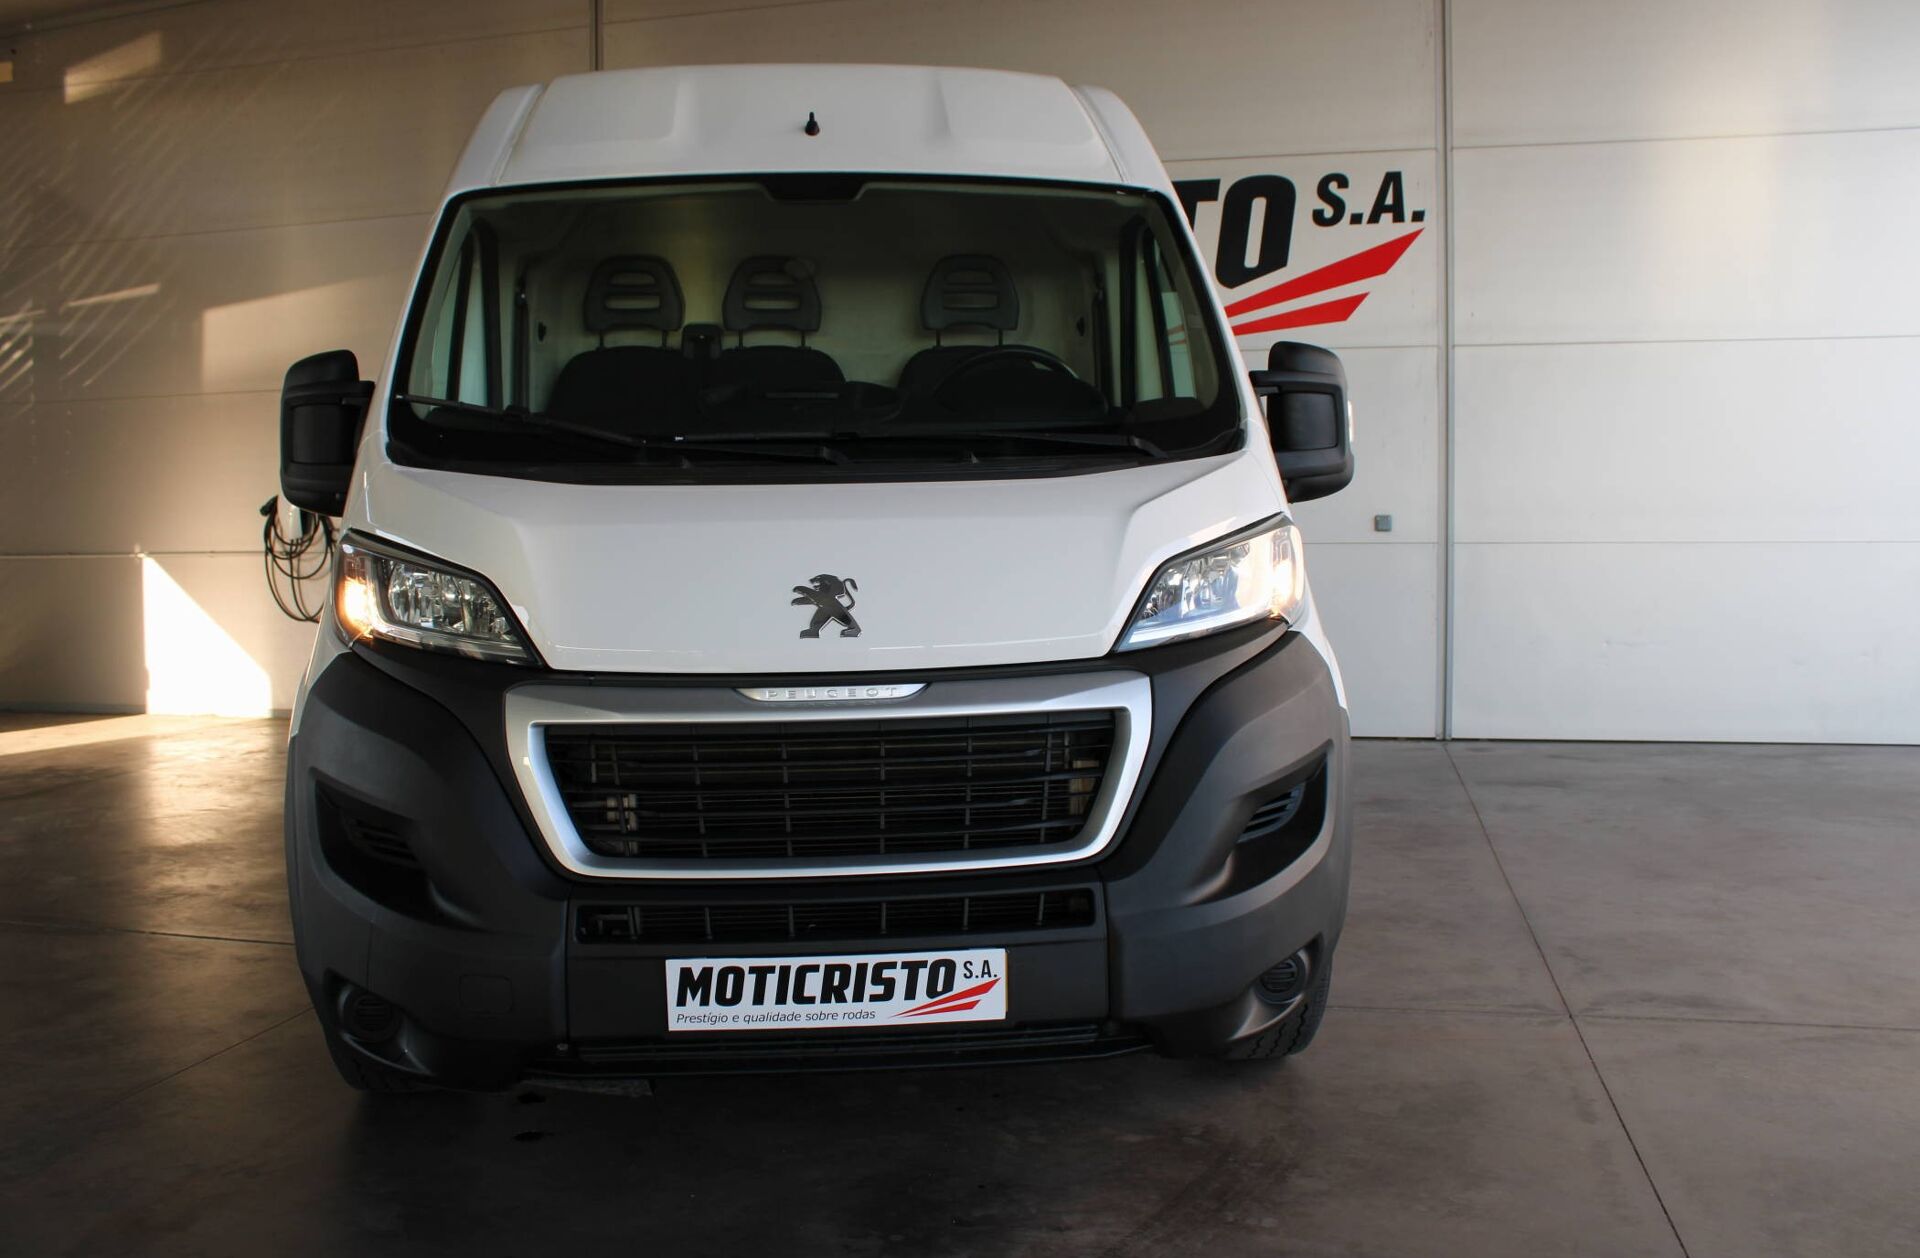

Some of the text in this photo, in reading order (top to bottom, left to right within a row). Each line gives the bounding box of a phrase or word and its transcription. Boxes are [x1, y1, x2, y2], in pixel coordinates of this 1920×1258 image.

[1172, 171, 1426, 290] O S.A.
[766, 687, 898, 699] PEUGEOT
[675, 958, 998, 1007] MOTICRISTO S.A.
[676, 1009, 876, 1025] Prestígio e qualidade sobre rodas
